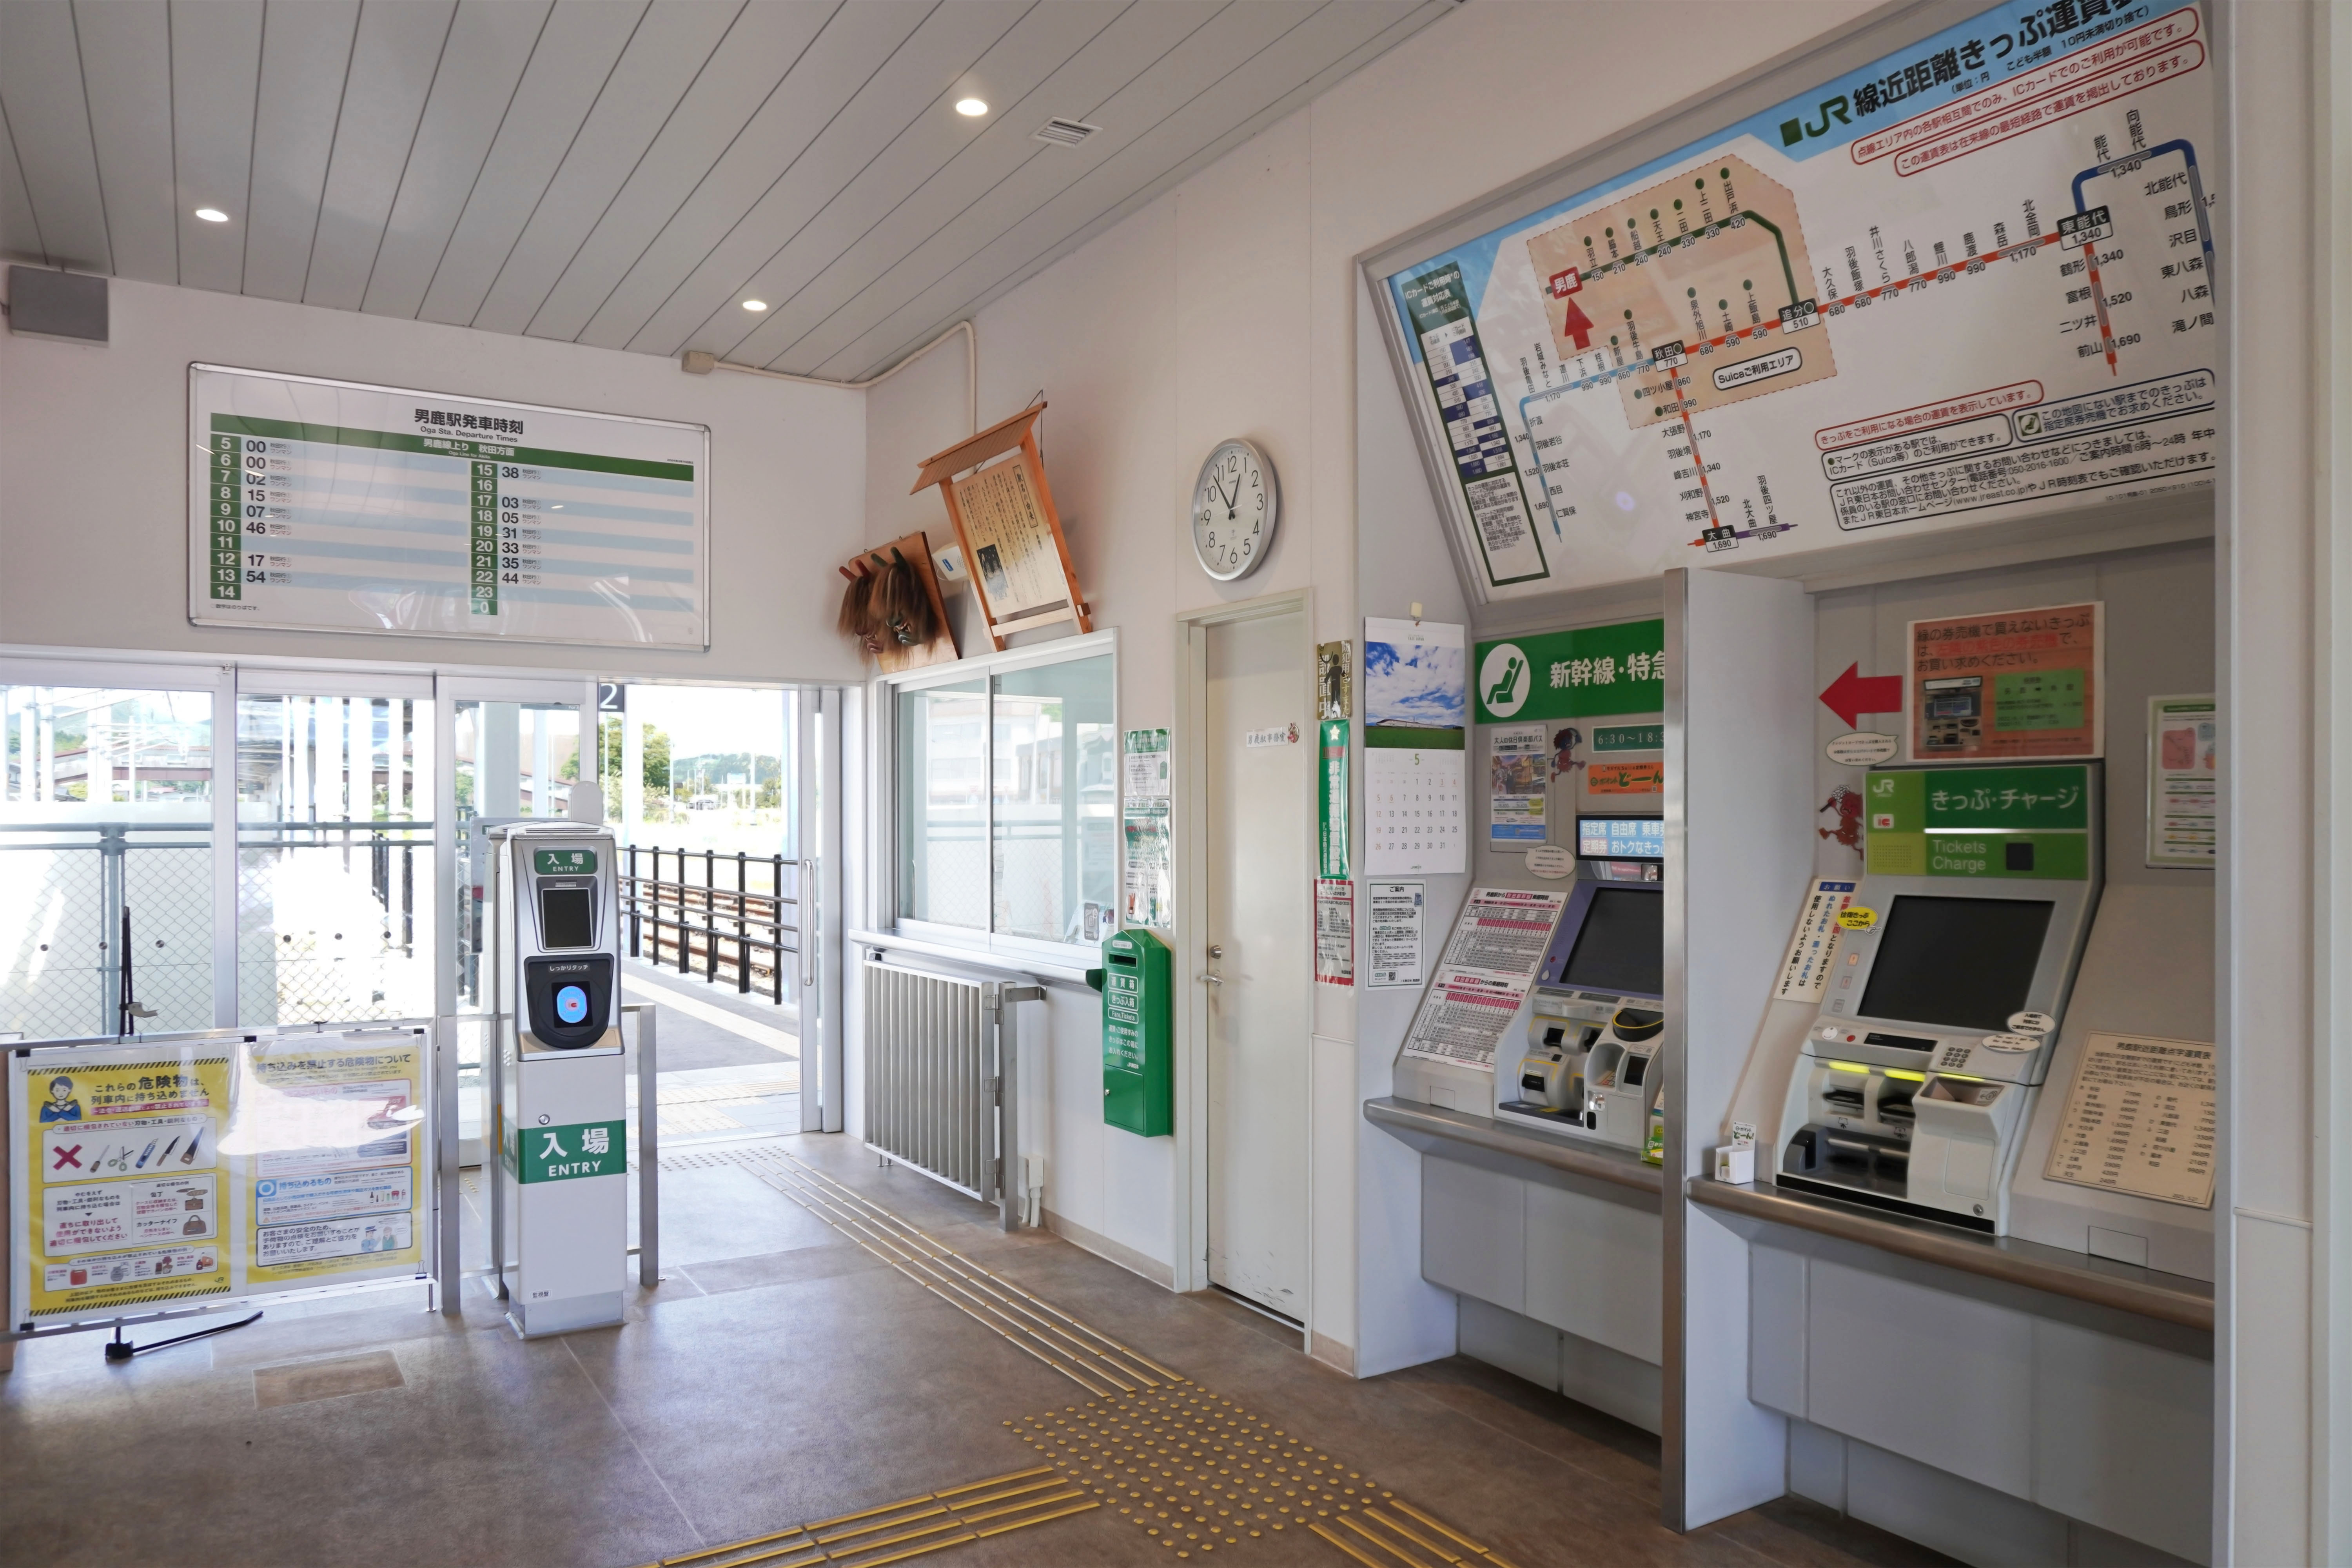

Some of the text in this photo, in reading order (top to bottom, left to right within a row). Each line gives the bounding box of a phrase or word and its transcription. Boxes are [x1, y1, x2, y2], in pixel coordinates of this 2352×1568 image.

[2007, 46, 2051, 71] こども半額
[1805, 0, 2134, 137] JR 線近距離きっぷ運賃
[2126, 109, 2146, 151] 向能代
[2094, 134, 2111, 163] 能代
[2110, 160, 2141, 178] 1,340
[2144, 173, 2187, 196] 北能代
[1724, 181, 1739, 213] 出戸浜
[1699, 191, 1713, 223] 上二田
[1730, 218, 1746, 229] 420
[2022, 198, 2040, 238] 北金岡
[2062, 211, 2106, 233] 東能代
[1653, 222, 1664, 241] 天王
[1994, 222, 2008, 247] 森岳
[1587, 248, 1598, 267] 羽立
[1657, 246, 1671, 257] 240
[1869, 225, 1891, 284] 井川さくら
[2009, 247, 2036, 263] 1,170
[1845, 245, 1864, 292] 羽後飯塚
[1555, 273, 1578, 294] 男鹿
[1592, 272, 1604, 282] 150
[1937, 271, 1956, 284] 990
[1691, 299, 1708, 340] 泉外旭川
[1782, 306, 1803, 321] 追分
[1793, 318, 1808, 328] 510
[1627, 321, 1643, 360] 羽後牛島
[1655, 347, 1673, 360] 秋田
[1664, 356, 1678, 367] 770
[1534, 343, 1552, 388] 岩城みなと
[1718, 355, 1793, 383] Suicaご利用エリア
[2042, 378, 2206, 420] この地図にない駅までのきっぷは
[1821, 389, 2031, 444] きっぷをご利用になる場合の運賃を表示しています。
[2044, 392, 2203, 432] 指定席券売機でお求めください。
[414, 408, 523, 434] 男鹿駅発車時刻
[456, 430, 493, 439] Departure
[496, 434, 517, 443] Times
[1662, 424, 1685, 437] 大張野
[221, 437, 266, 452] 5 00
[424, 438, 514, 456] 男鹿線上り 秋田方面
[1536, 436, 1563, 449] 羽後岩谷
[221, 454, 266, 469] 6 00
[1228, 456, 1236, 473] 12
[221, 471, 266, 485] 7 02
[477, 464, 519, 478] 15 38
[1252, 470, 1258, 487] 2
[221, 487, 265, 501] 8 15
[477, 495, 519, 508] 17 03
[1017, 474, 1034, 521] 駅名の由来
[1207, 486, 1216, 503] 10
[1757, 475, 1777, 524] 羽後四ツ屋
[1841, 478, 2020, 515] 係員のいる駅の窓口にお問い合わせください。
[221, 503, 265, 517] 9 07
[477, 510, 519, 524] 18 05
[218, 520, 265, 534] 10 46
[477, 525, 516, 539] 19 31
[1708, 528, 1731, 540] 大曲
[476, 541, 519, 554] 20 33
[1209, 532, 1215, 548] 8
[218, 553, 264, 566] 12 17
[476, 556, 519, 569] 21 35
[1230, 547, 1237, 564] 6
[218, 570, 265, 583] 13 54
[476, 571, 519, 584] 22 44
[1917, 613, 2090, 642] 緑の券売機で買えないきっぷ
[1550, 650, 1664, 689] 新幹線・特急
[1917, 653, 2038, 672] お買い求めください。
[1341, 643, 1351, 715] 防犯用さすまた
[600, 682, 618, 709] 2
[1494, 734, 1543, 744] 大人の休日倶楽部パス
[1415, 753, 1419, 765] 5
[1873, 779, 1895, 793] JR
[1932, 786, 2079, 811] きっぷ・チャージ
[1583, 822, 1606, 836] 指定席
[1612, 822, 1636, 836] 自由席
[1583, 840, 1607, 853] 定期券
[1933, 839, 1986, 854] Tickets
[547, 853, 584, 865] 入場
[1933, 856, 1986, 873] Charge
[1782, 895, 1822, 995] 使用しないようお願いします
[1111, 976, 1134, 990] 運賃箱
[1455, 976, 1480, 984] 秋田新幹線
[1111, 994, 1134, 1008] きっぷ入箱
[1109, 1024, 1138, 1038] 運賃・ご使用ずみの
[1109, 1035, 1138, 1049] きっぷはこの箱に
[1109, 1046, 1138, 1060] お入れください。
[2117, 1042, 2211, 1060] 男鹿駅近距離点字運賃表
[256, 1053, 411, 1074] 持ち込みを禁止する危険物について
[95, 1074, 205, 1093] これらの危険物は、
[91, 1088, 210, 1105] 列車内に持ち込めません
[539, 1128, 610, 1160] 入場
[548, 1160, 602, 1177] ENTRY
[279, 1177, 332, 1190] 持ち込めるもの
[59, 1218, 118, 1229] 直ちに取り出して
[136, 1218, 177, 1228] カッターナイフ
[263, 1224, 332, 1237] お客さまの安全のため、
[49, 1232, 128, 1247] 適切に梱包してください
[56, 1225, 121, 1238] 使用ができないよう
[263, 1227, 360, 1243] 手荷物の点検をお願いすることが
[263, 1234, 357, 1250] ありますので、ご理解とご協力を
[263, 1245, 317, 1257] お願いいたします。
